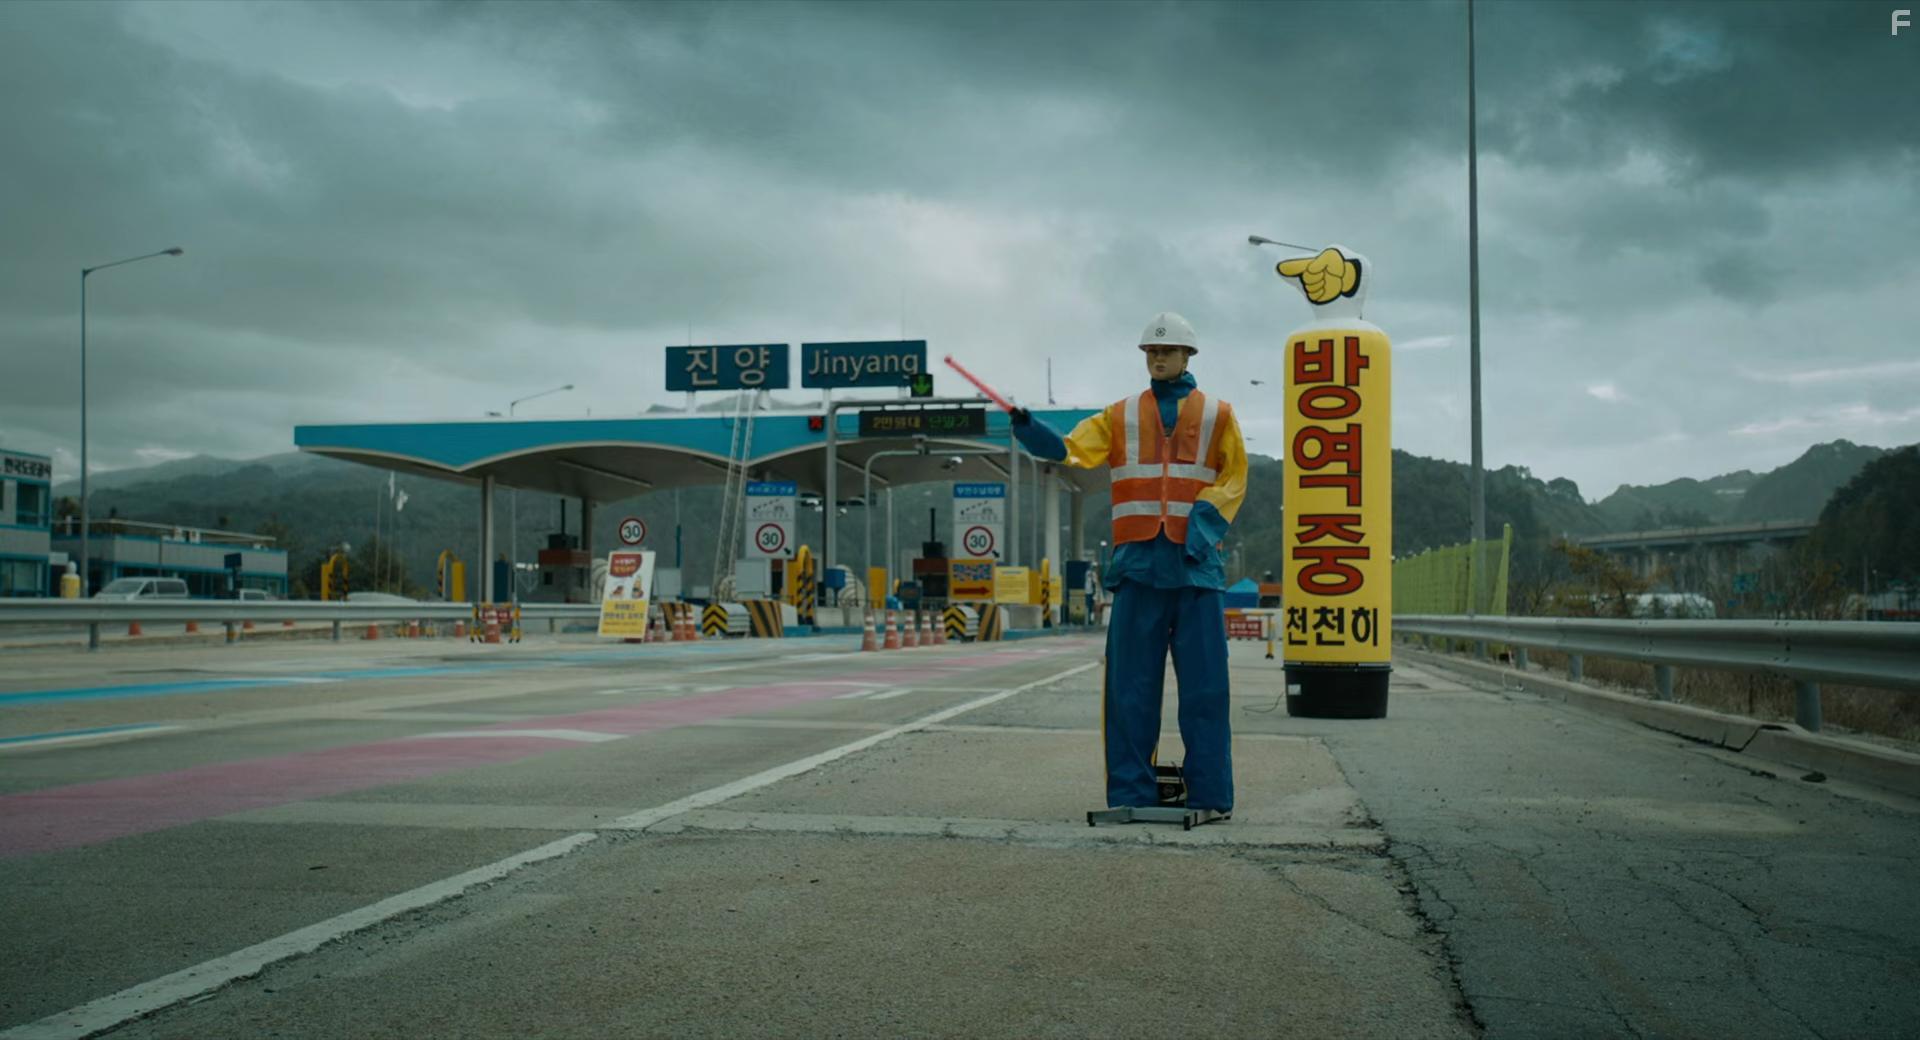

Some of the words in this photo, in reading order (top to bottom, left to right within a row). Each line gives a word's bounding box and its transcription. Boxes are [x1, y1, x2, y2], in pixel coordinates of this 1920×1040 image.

[808, 349, 919, 381] Jinyang
[1292, 336, 1370, 596] 방역중
[623, 525, 641, 540] 30
[762, 532, 779, 546] 30
[969, 535, 987, 548] 30
[1286, 606, 1379, 647] 천천히
